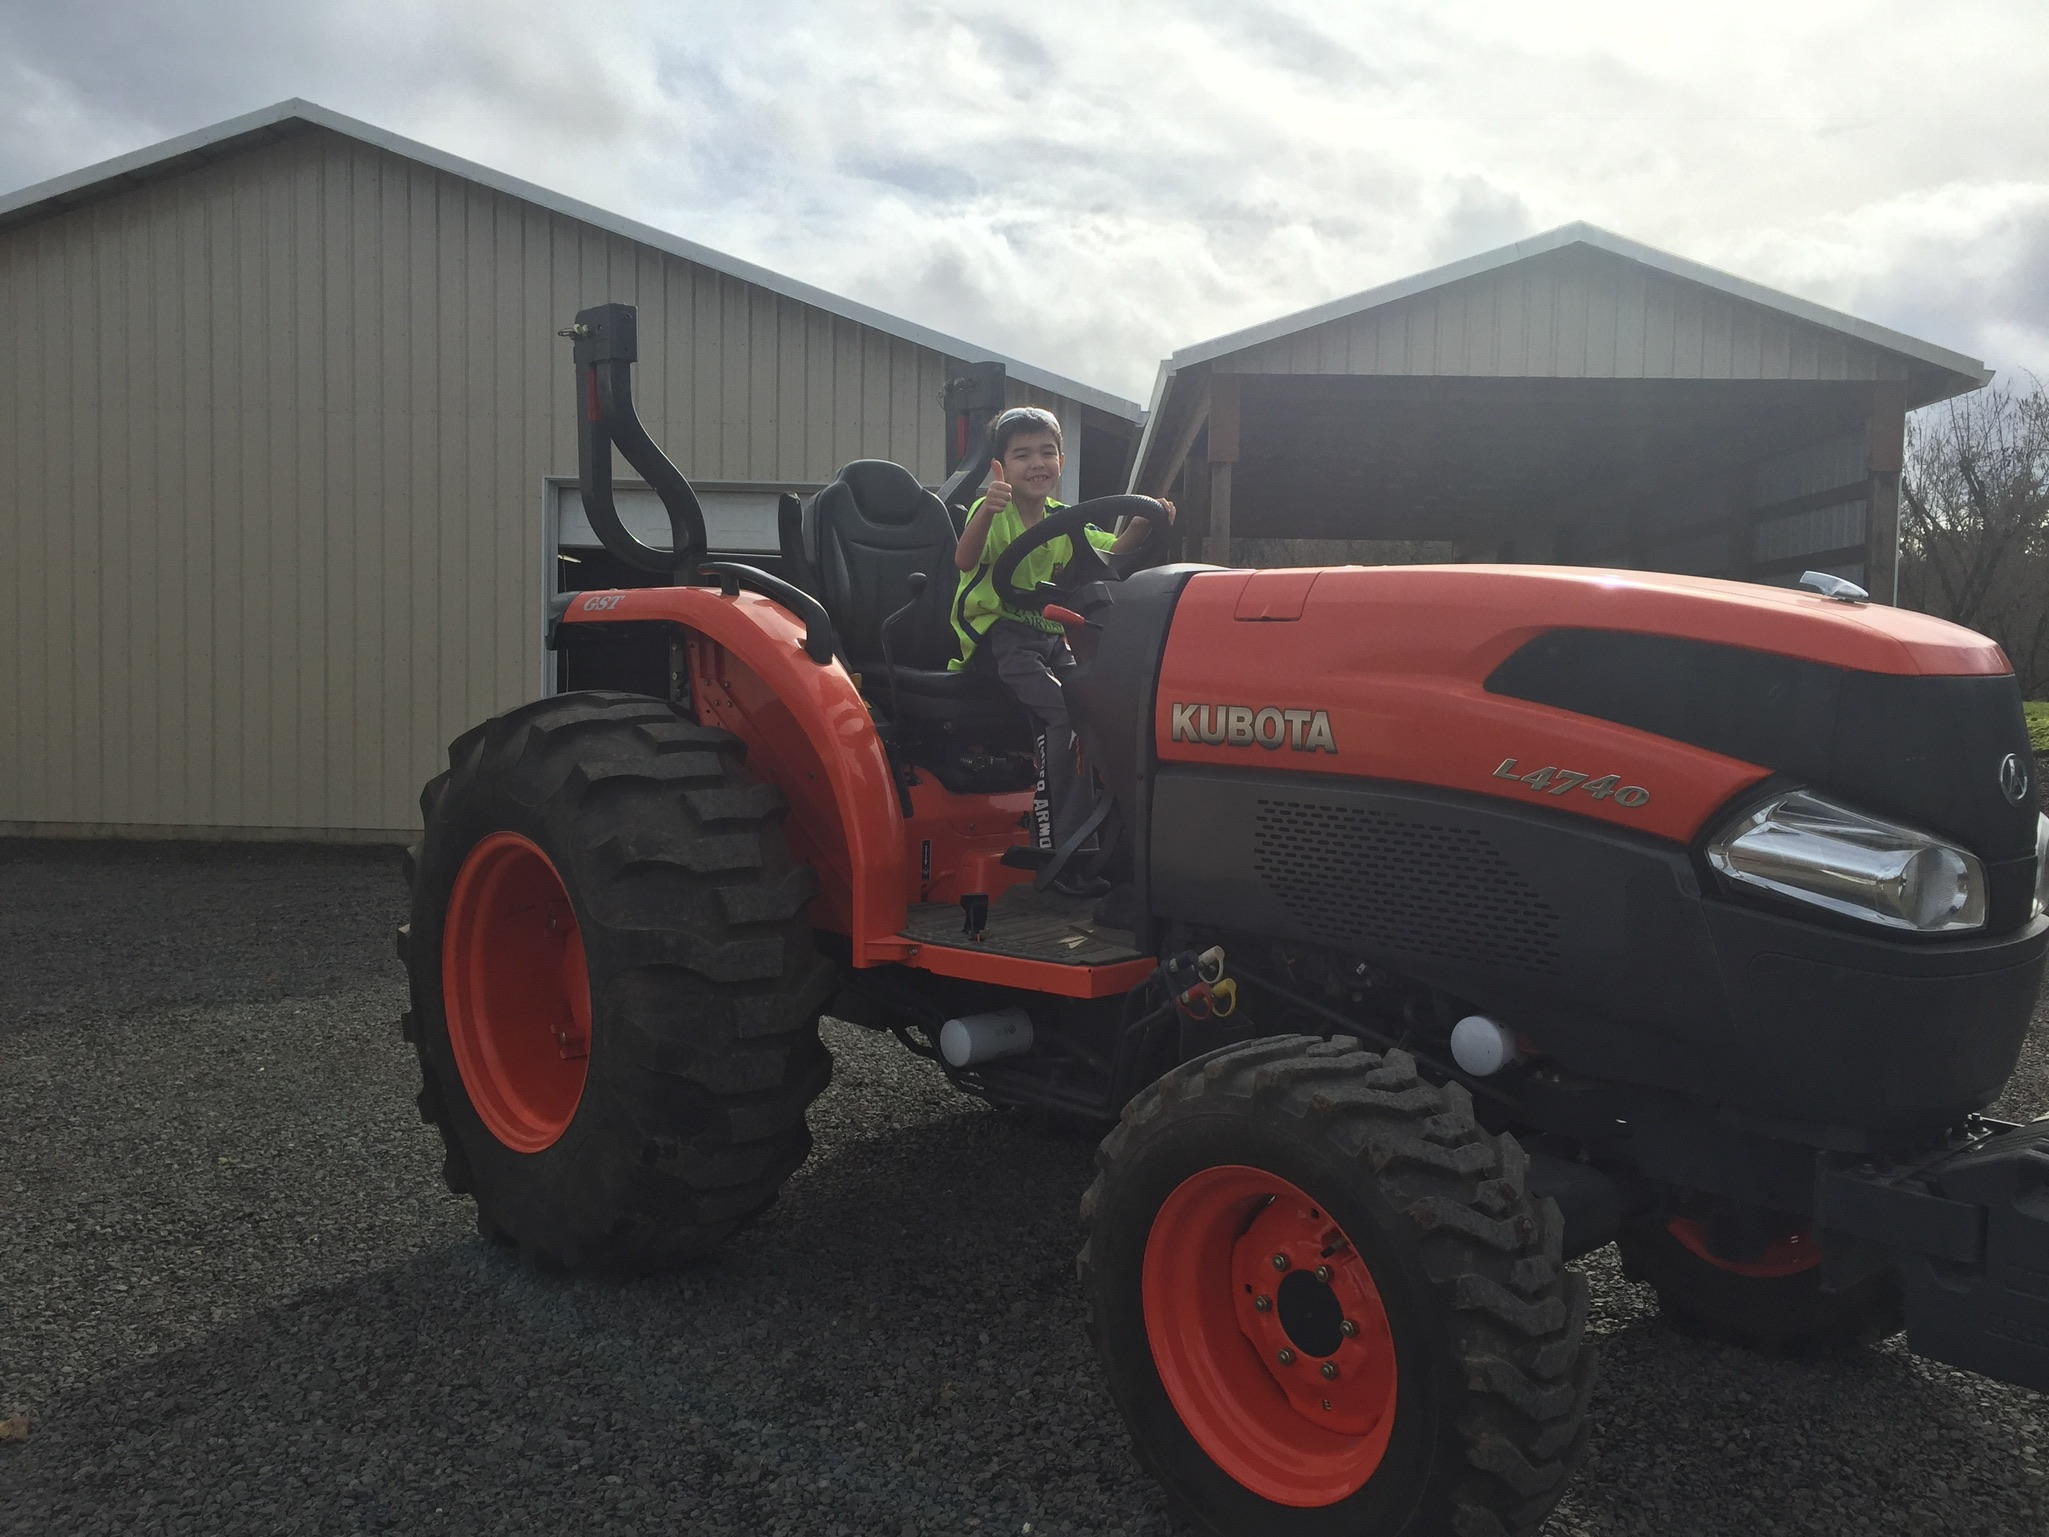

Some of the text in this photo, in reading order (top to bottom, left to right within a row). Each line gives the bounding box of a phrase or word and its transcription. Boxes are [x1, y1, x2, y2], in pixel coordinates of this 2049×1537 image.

[583, 595, 626, 611] GST
[1172, 703, 1337, 754] KUBOTA
[1492, 757, 1650, 807] L4740
